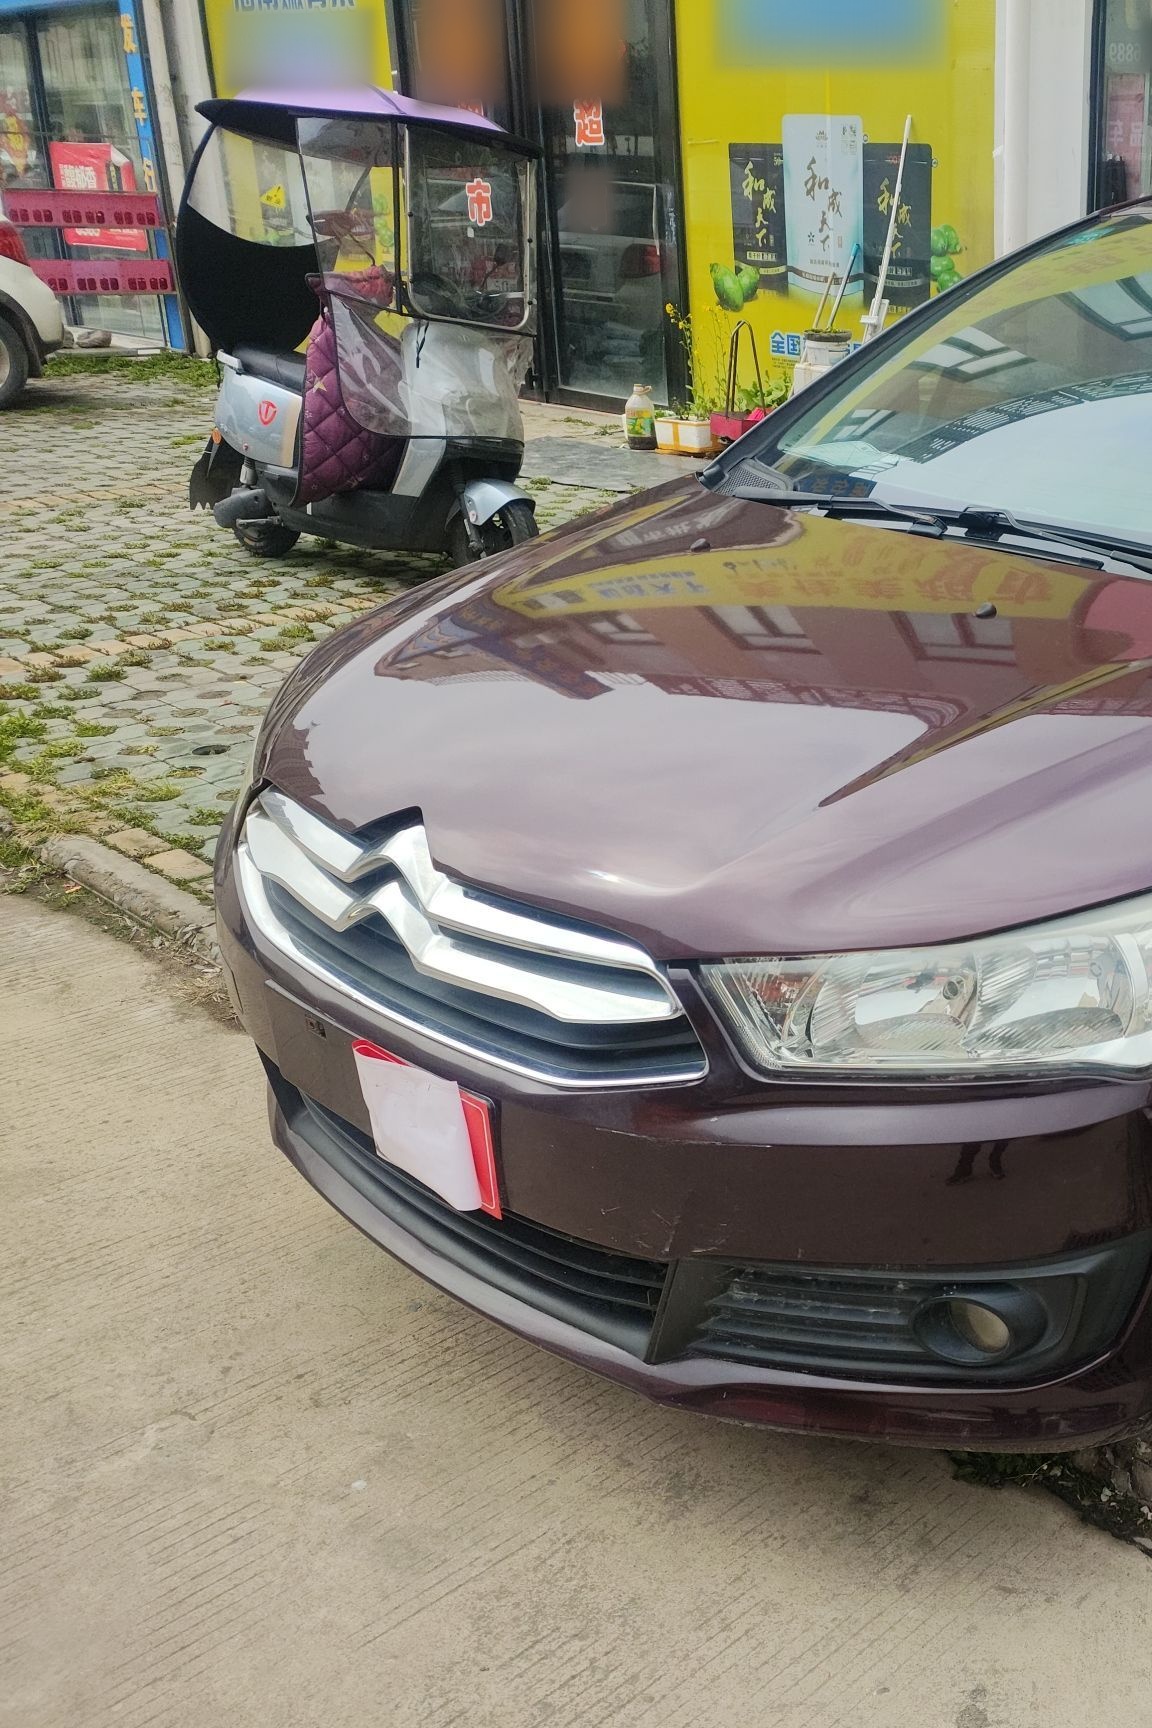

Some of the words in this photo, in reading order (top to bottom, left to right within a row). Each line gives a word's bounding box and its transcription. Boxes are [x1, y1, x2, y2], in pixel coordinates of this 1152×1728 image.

[465, 177, 493, 227] 市
[742, 160, 777, 248] 和成天下
[803, 156, 843, 253] 和成天下
